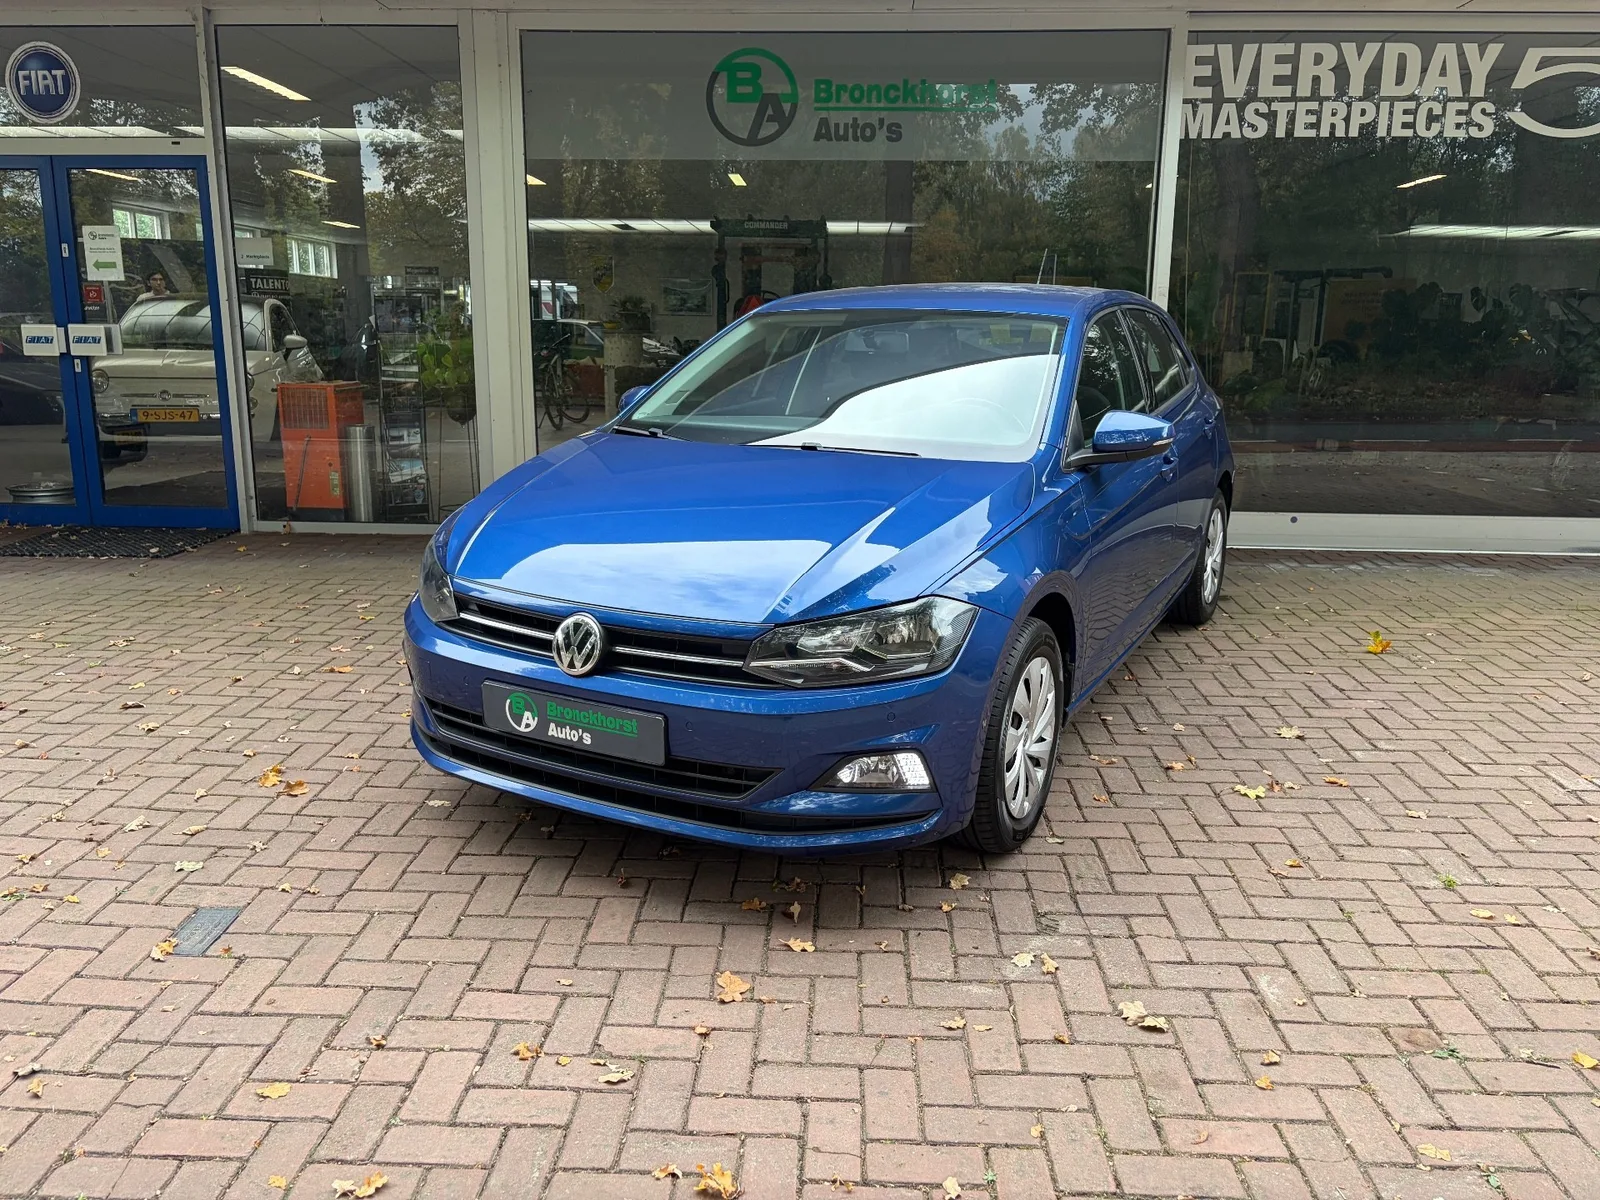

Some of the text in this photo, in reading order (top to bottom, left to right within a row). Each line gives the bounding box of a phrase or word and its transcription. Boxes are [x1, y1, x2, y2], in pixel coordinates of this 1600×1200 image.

[18, 69, 66, 96] FIAT
[1182, 42, 1505, 99] EVERYDAY
[813, 78, 998, 105] Bronckhorst
[813, 116, 903, 143] Auto's
[1180, 100, 1496, 140] MASTERPIECES
[744, 221, 788, 229] COMMANDER
[26, 336, 54, 344] FIAT
[73, 336, 101, 344] FIAT
[547, 701, 638, 733] Bronckhorst
[548, 722, 592, 745] Auto's
